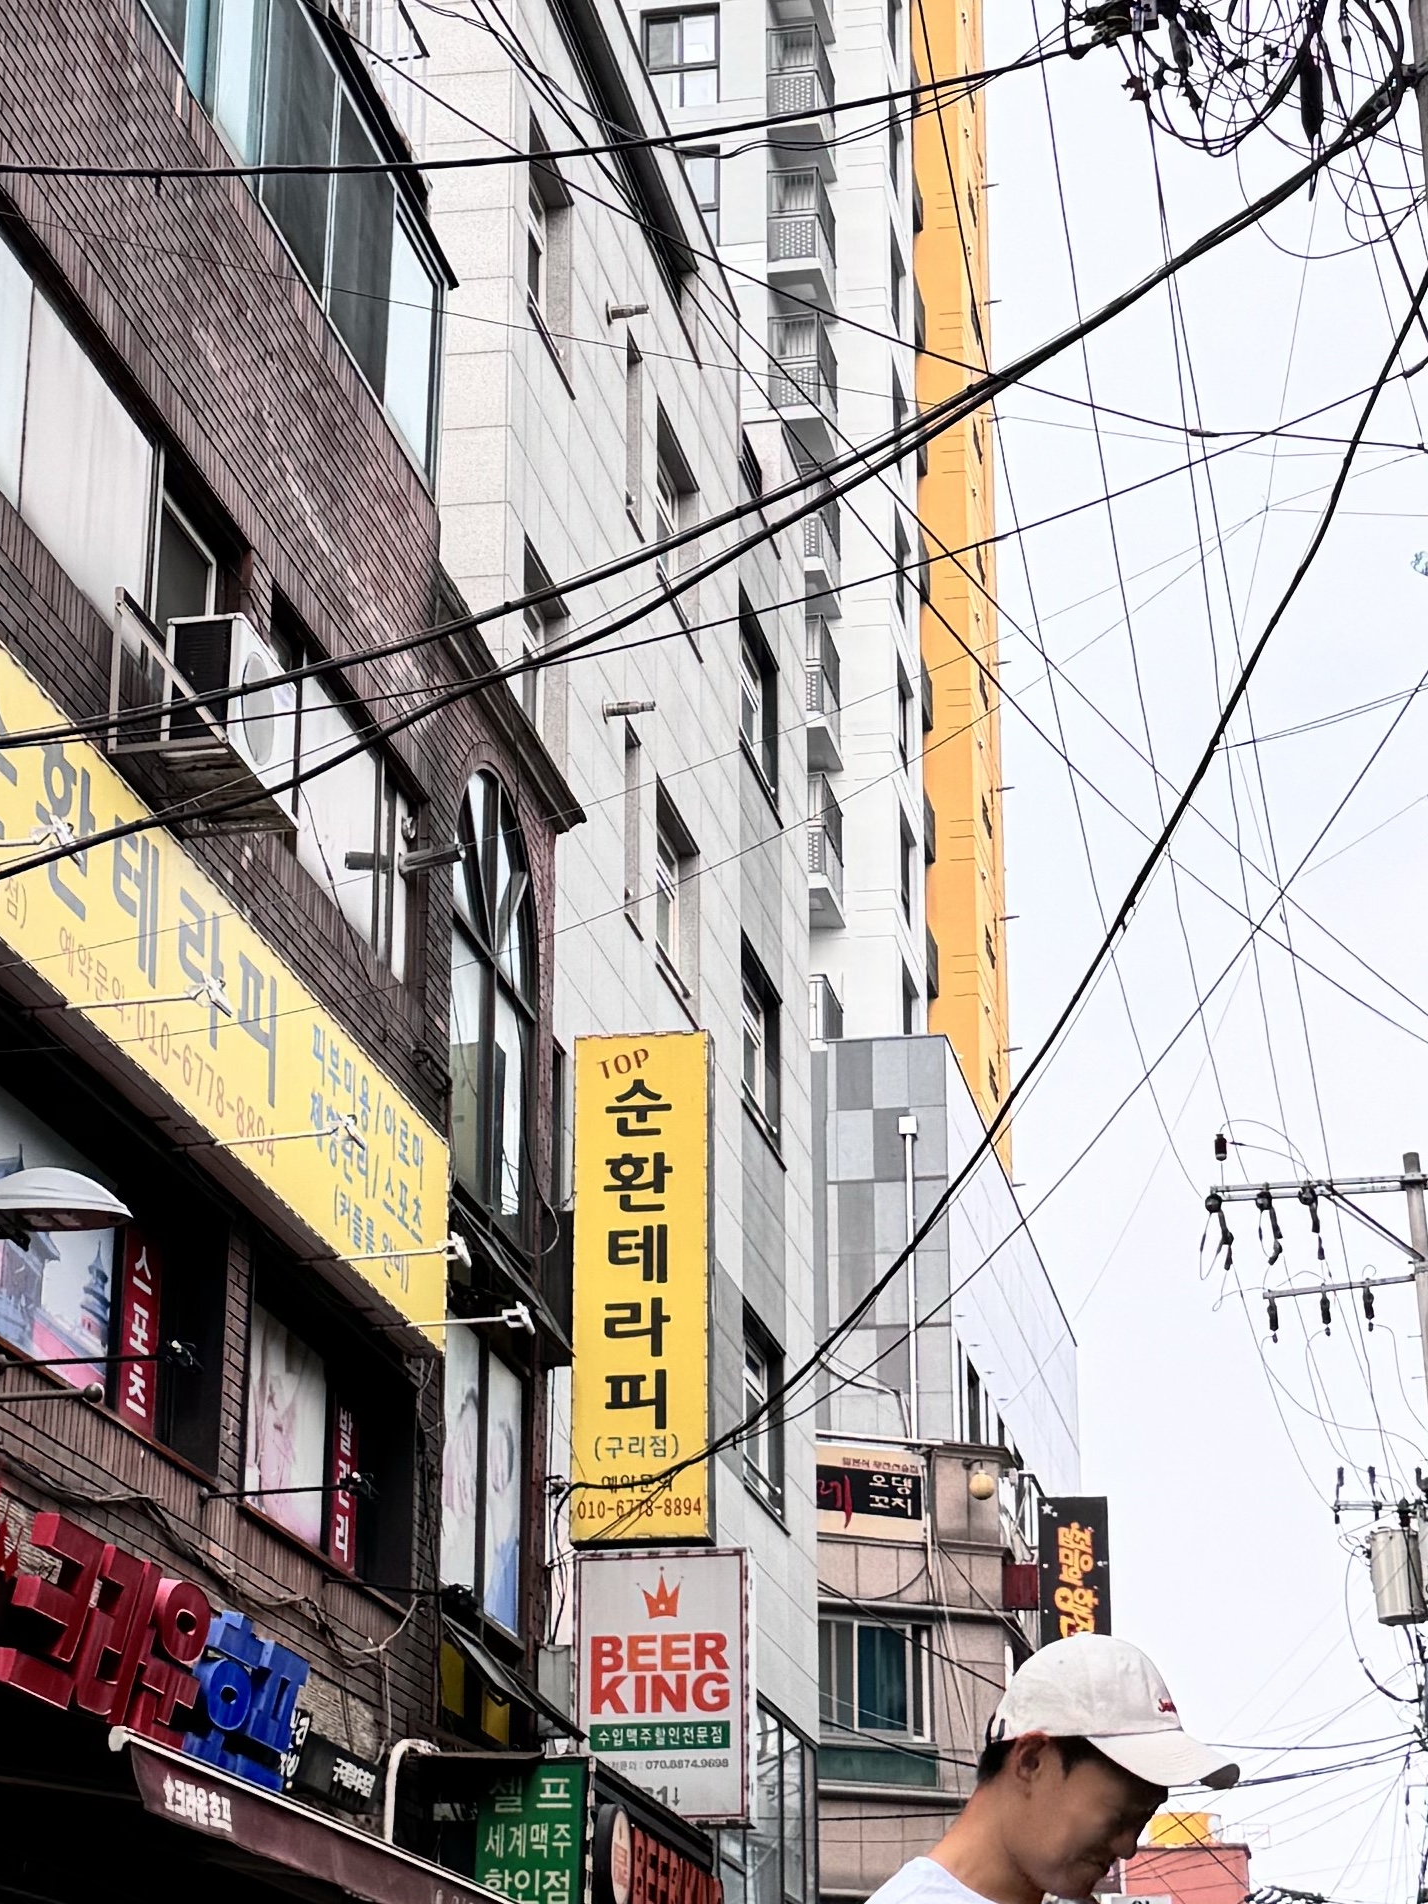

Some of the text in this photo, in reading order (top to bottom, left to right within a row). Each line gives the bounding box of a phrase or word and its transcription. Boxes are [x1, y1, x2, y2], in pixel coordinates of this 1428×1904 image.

[597, 1048, 650, 1080] TOP
[603, 1078, 674, 1431] 순환테라피
[593, 1433, 680, 1463] (구리점)
[869, 1473, 913, 1495] 오뎅
[576, 1496, 703, 1522] 010-6778-8894
[868, 1493, 913, 1517] 꼬치
[590, 1632, 729, 1675] BEER
[590, 1672, 731, 1715] KING
[597, 1722, 724, 1748] 수입맥주할인전문점
[484, 1821, 573, 1860] 세계맥주
